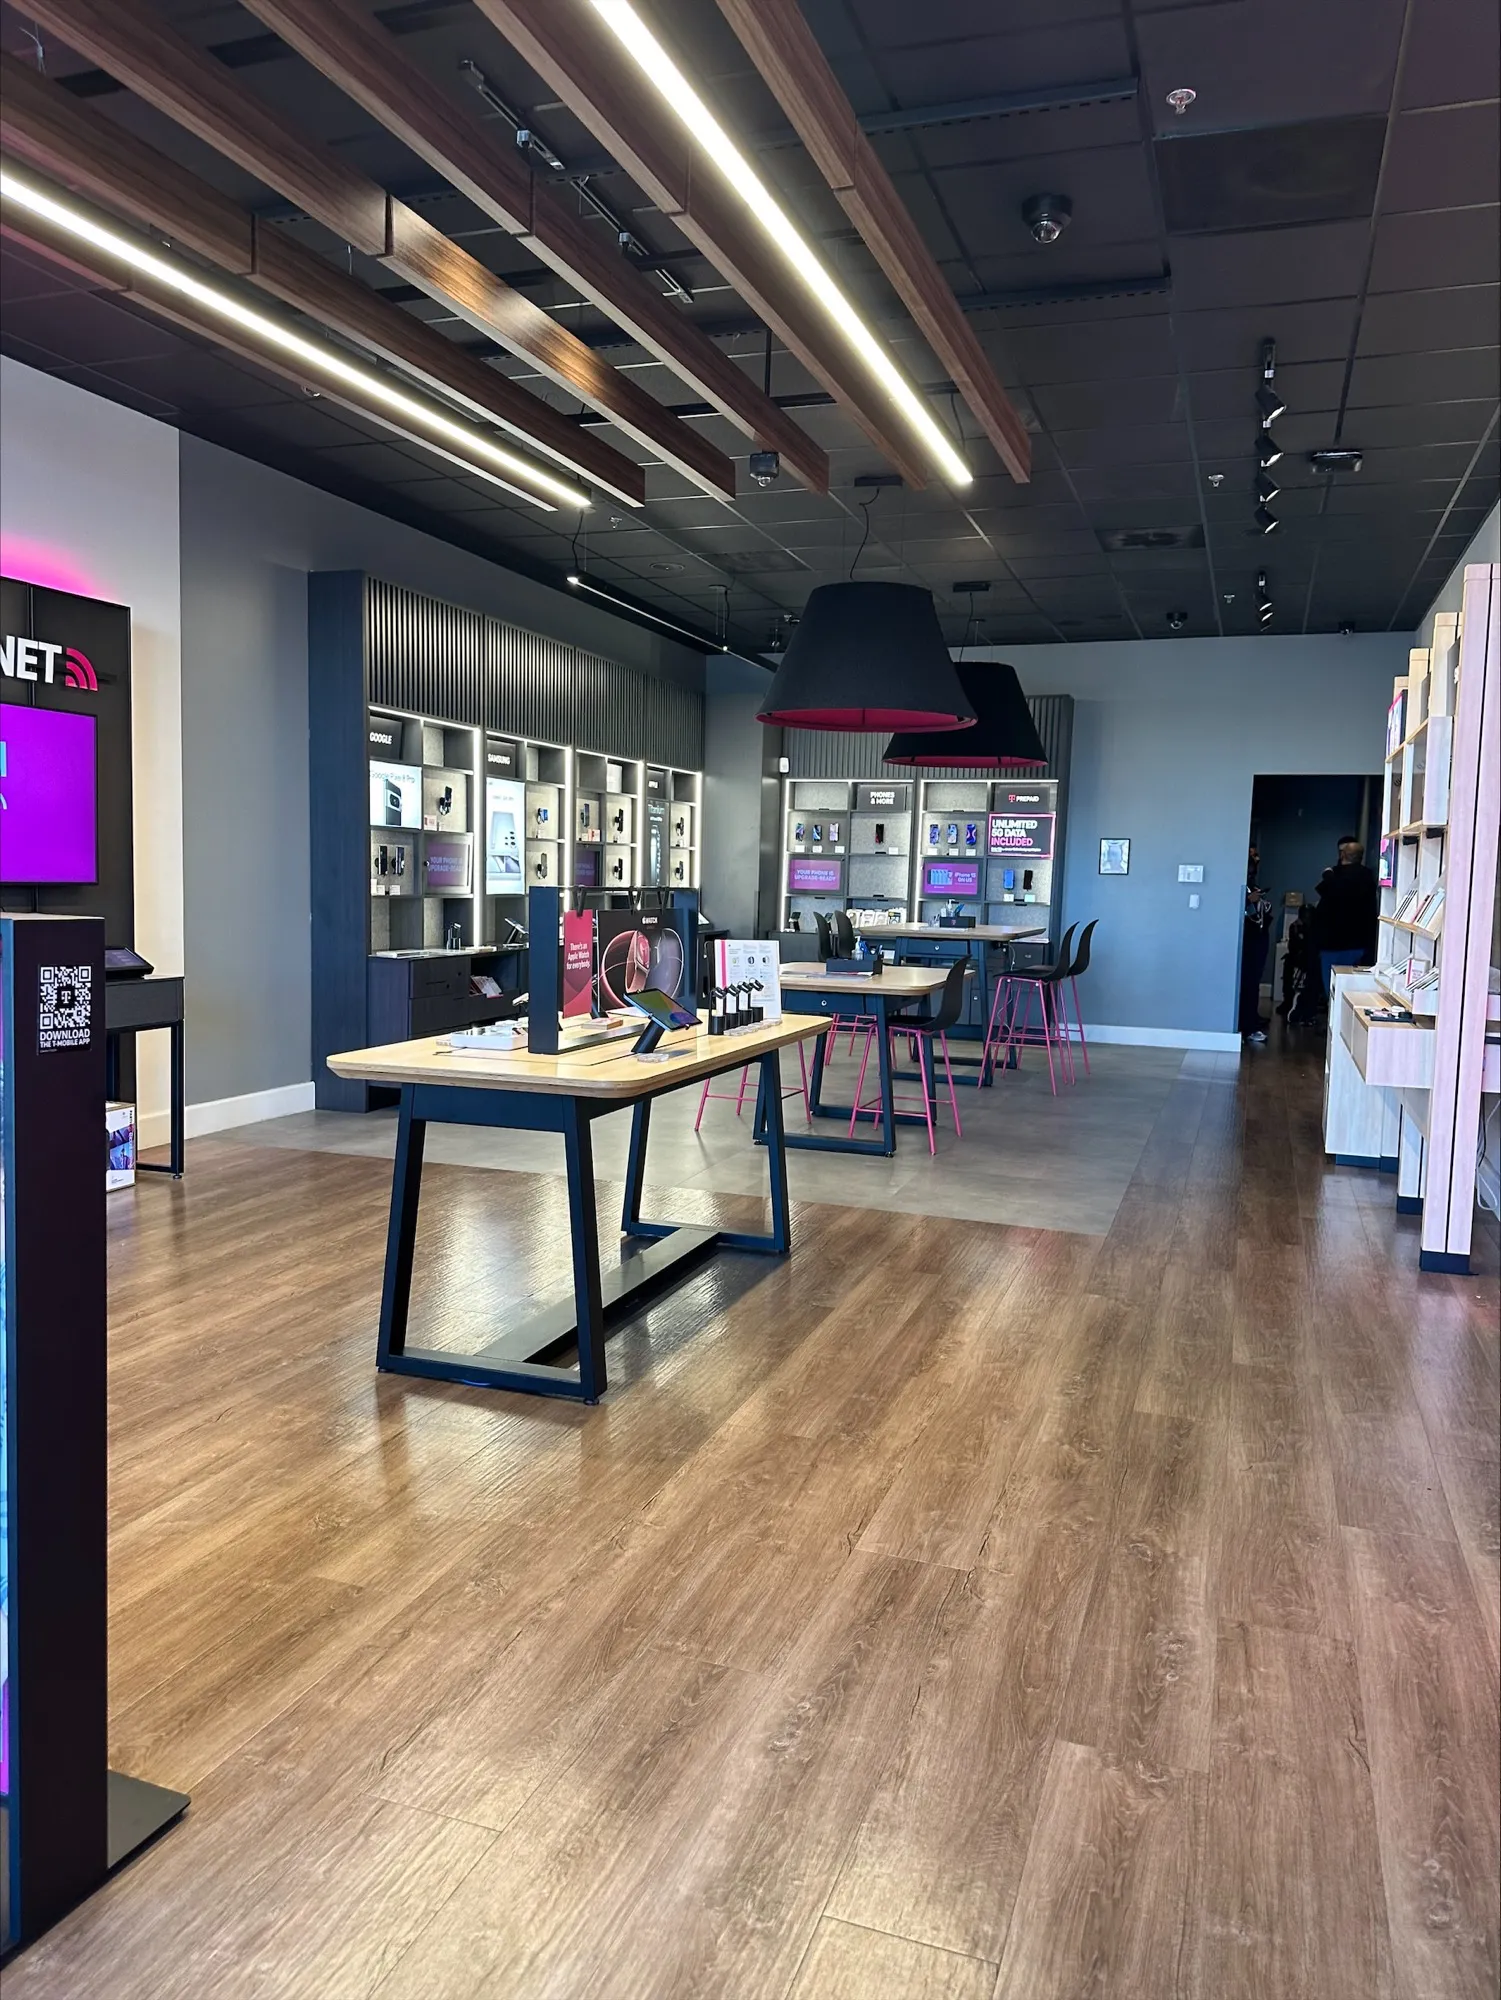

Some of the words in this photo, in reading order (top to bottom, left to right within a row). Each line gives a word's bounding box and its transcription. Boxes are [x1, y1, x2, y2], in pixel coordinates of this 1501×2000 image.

[370, 732, 392, 745] GOOGLE
[488, 753, 511, 765] SAMSUNG
[992, 819, 1038, 829] UNLIMITED
[1004, 829, 1027, 837] DATA
[991, 837, 1034, 846] INCLUDED
[578, 951, 590, 959] Watch
[40, 1029, 91, 1040] DOWNLOAD
[40, 1040, 51, 1048] THE
[52, 1038, 78, 1048] T-MOBILE
[79, 1037, 91, 1045] APP
